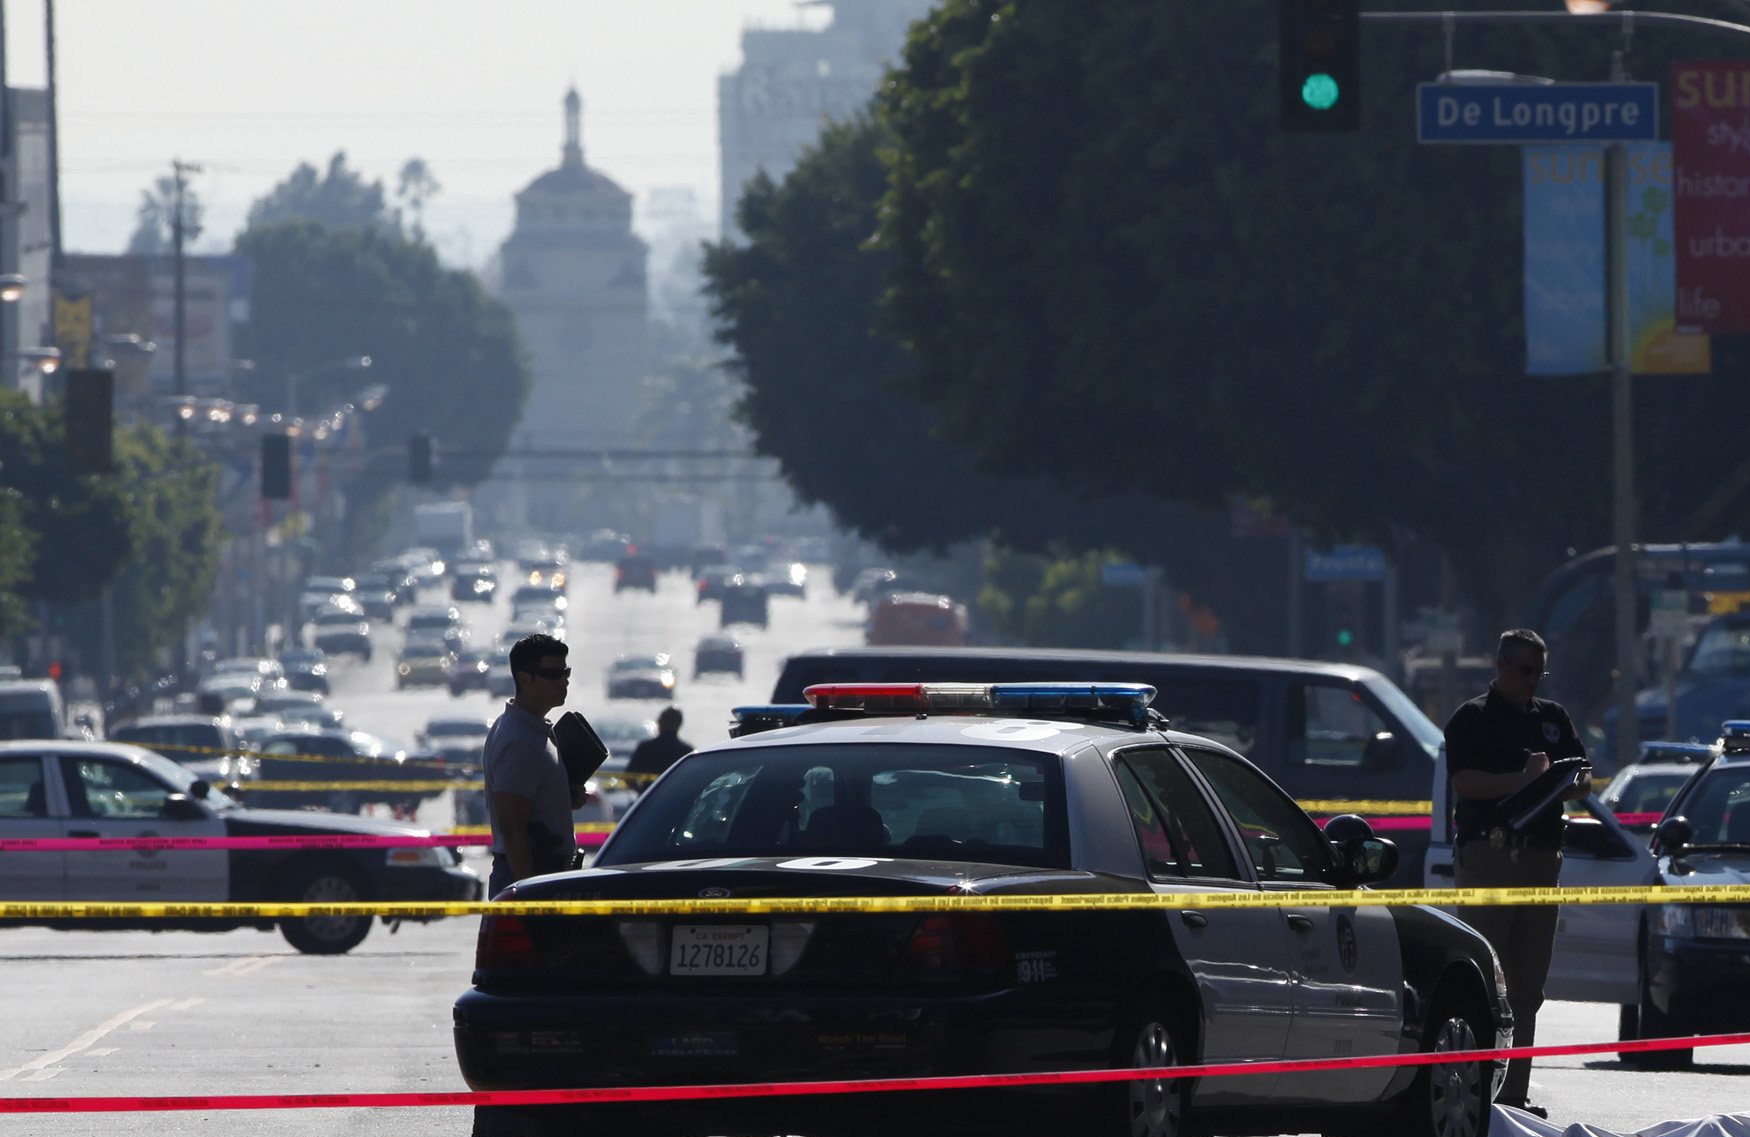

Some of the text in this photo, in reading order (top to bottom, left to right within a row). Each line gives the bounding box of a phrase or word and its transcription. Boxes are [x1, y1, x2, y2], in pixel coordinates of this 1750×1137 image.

[1437, 96, 1640, 135] De Longpre
[1677, 286, 1721, 319] life
[695, 931, 745, 941] CA EXEMPT
[677, 943, 761, 968] 1278126
